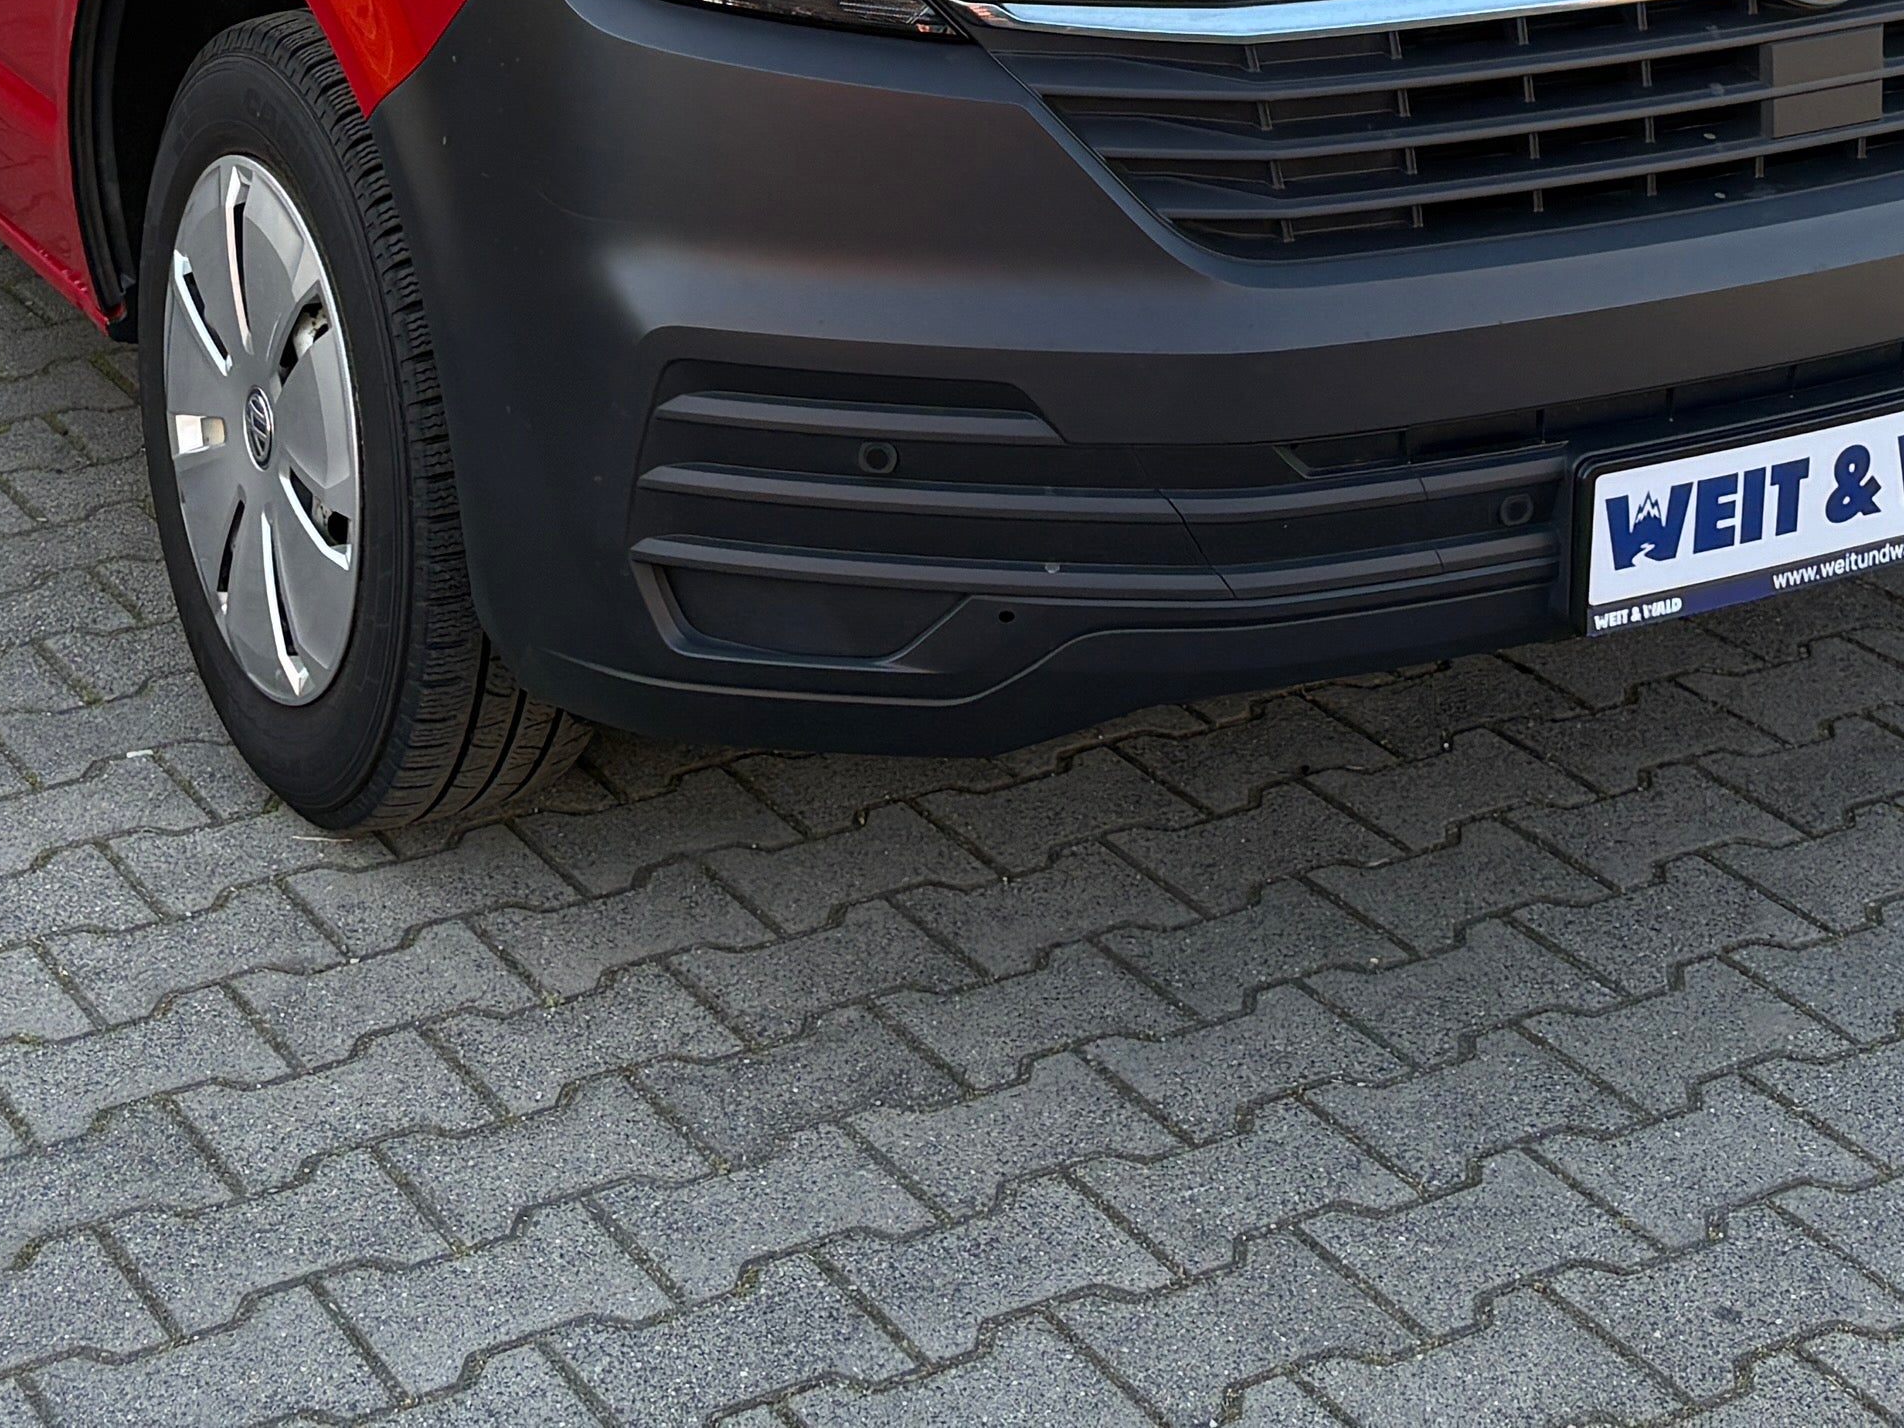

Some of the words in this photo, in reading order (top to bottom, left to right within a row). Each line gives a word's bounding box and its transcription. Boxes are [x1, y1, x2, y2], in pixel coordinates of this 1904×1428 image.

[1605, 456, 1810, 571] WEIT
[1824, 443, 1882, 524] &
[1593, 608, 1629, 631] WEIT
[1630, 605, 1642, 622] &
